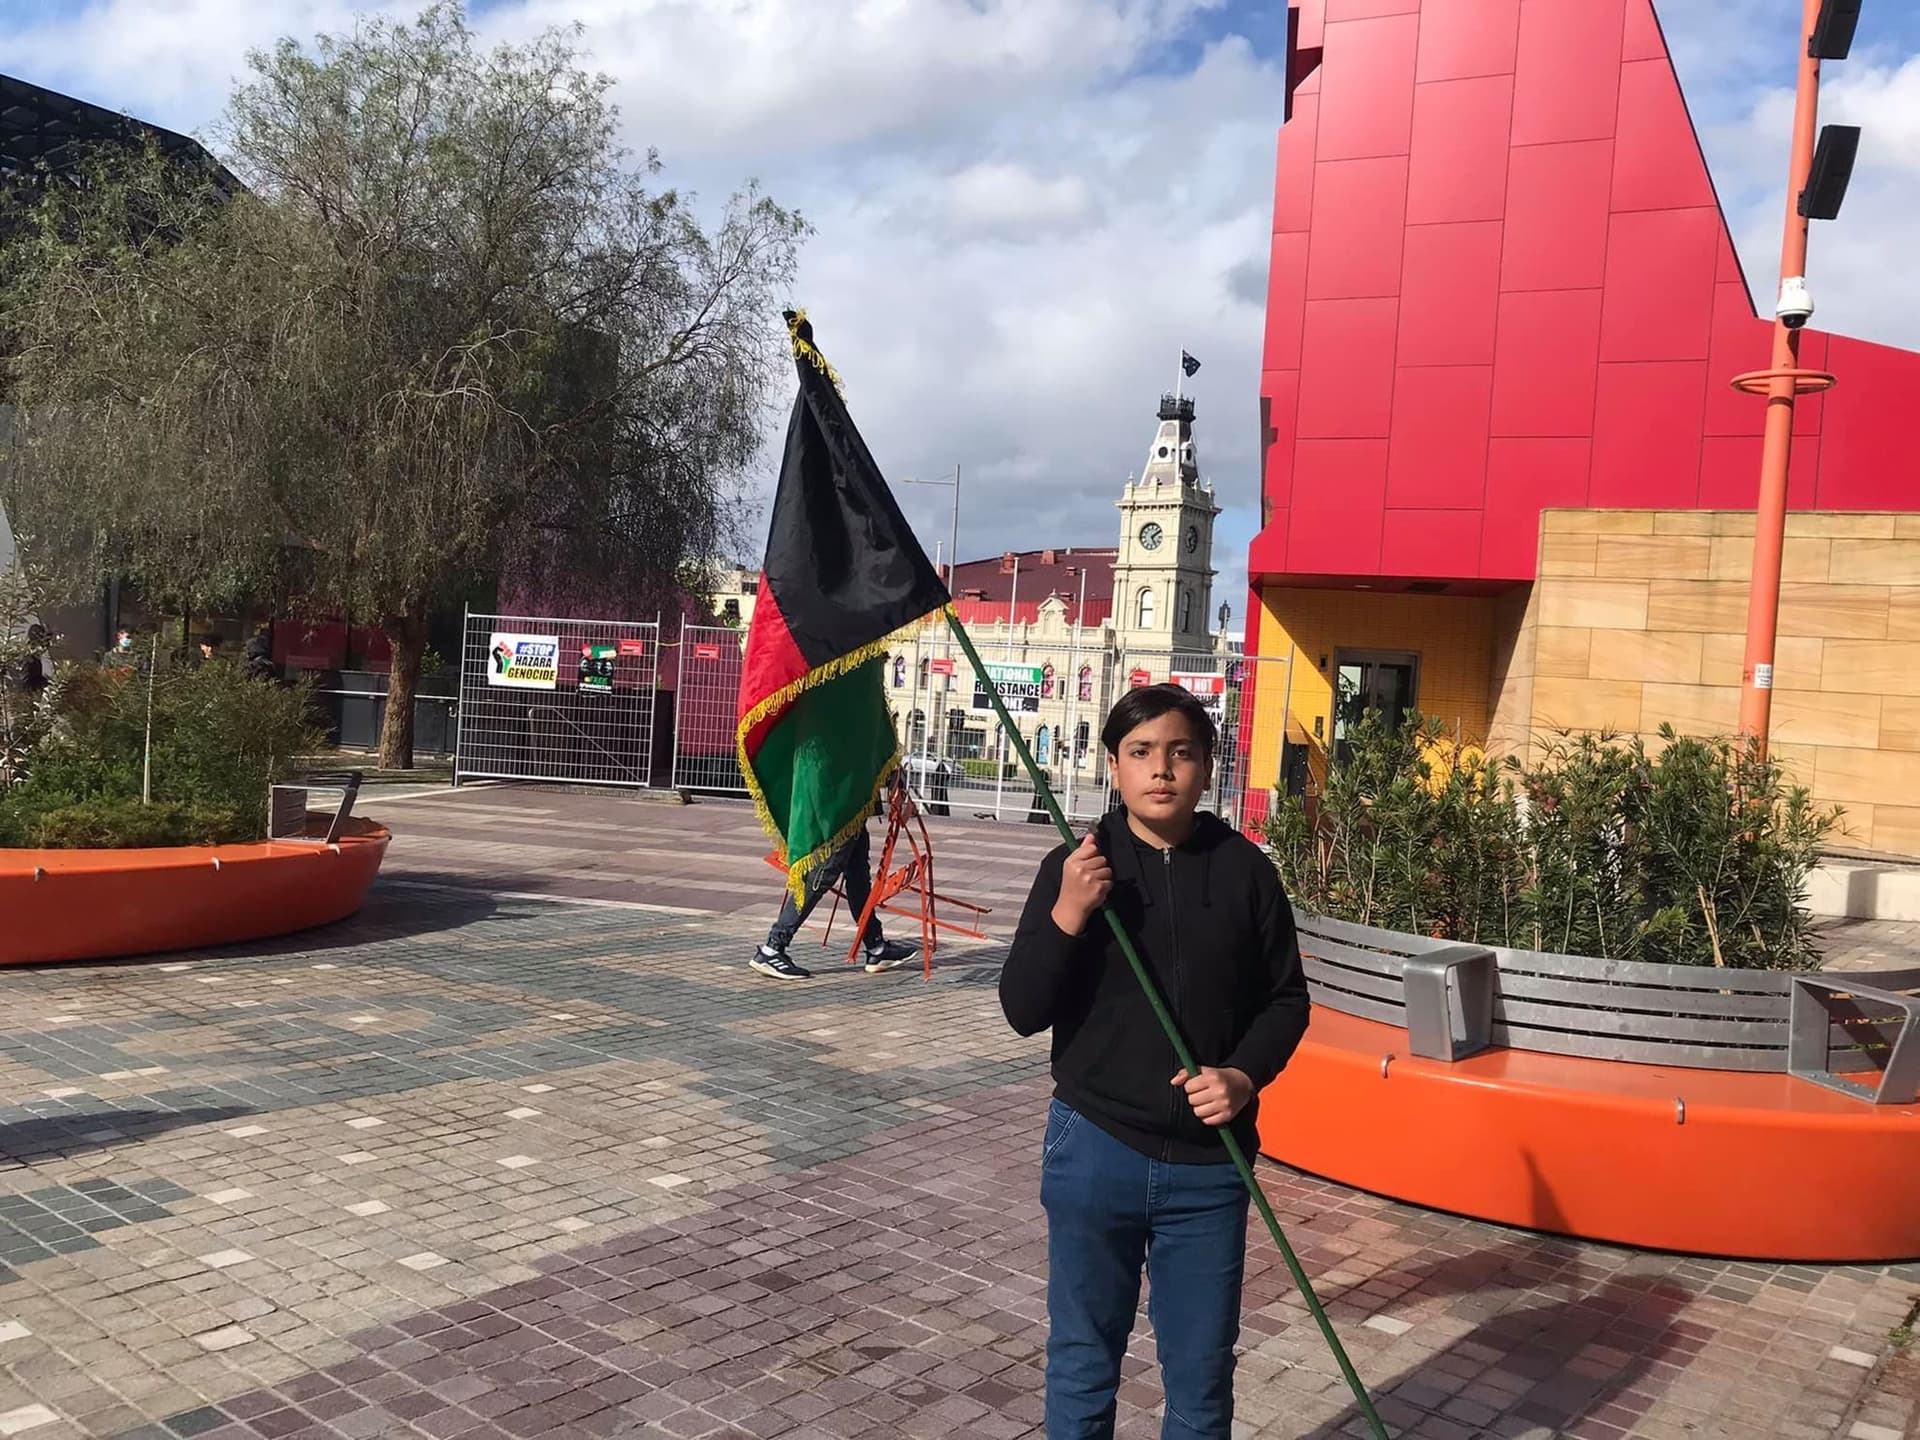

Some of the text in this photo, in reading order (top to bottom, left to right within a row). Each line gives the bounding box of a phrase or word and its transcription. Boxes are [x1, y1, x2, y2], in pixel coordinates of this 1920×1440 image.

[519, 644, 553, 655] #STOP
[515, 656, 552, 668] HAZARA
[508, 668, 555, 681] GENOCIDE
[975, 681, 1040, 697] RISTANCE
[1193, 678, 1212, 693] NOT
